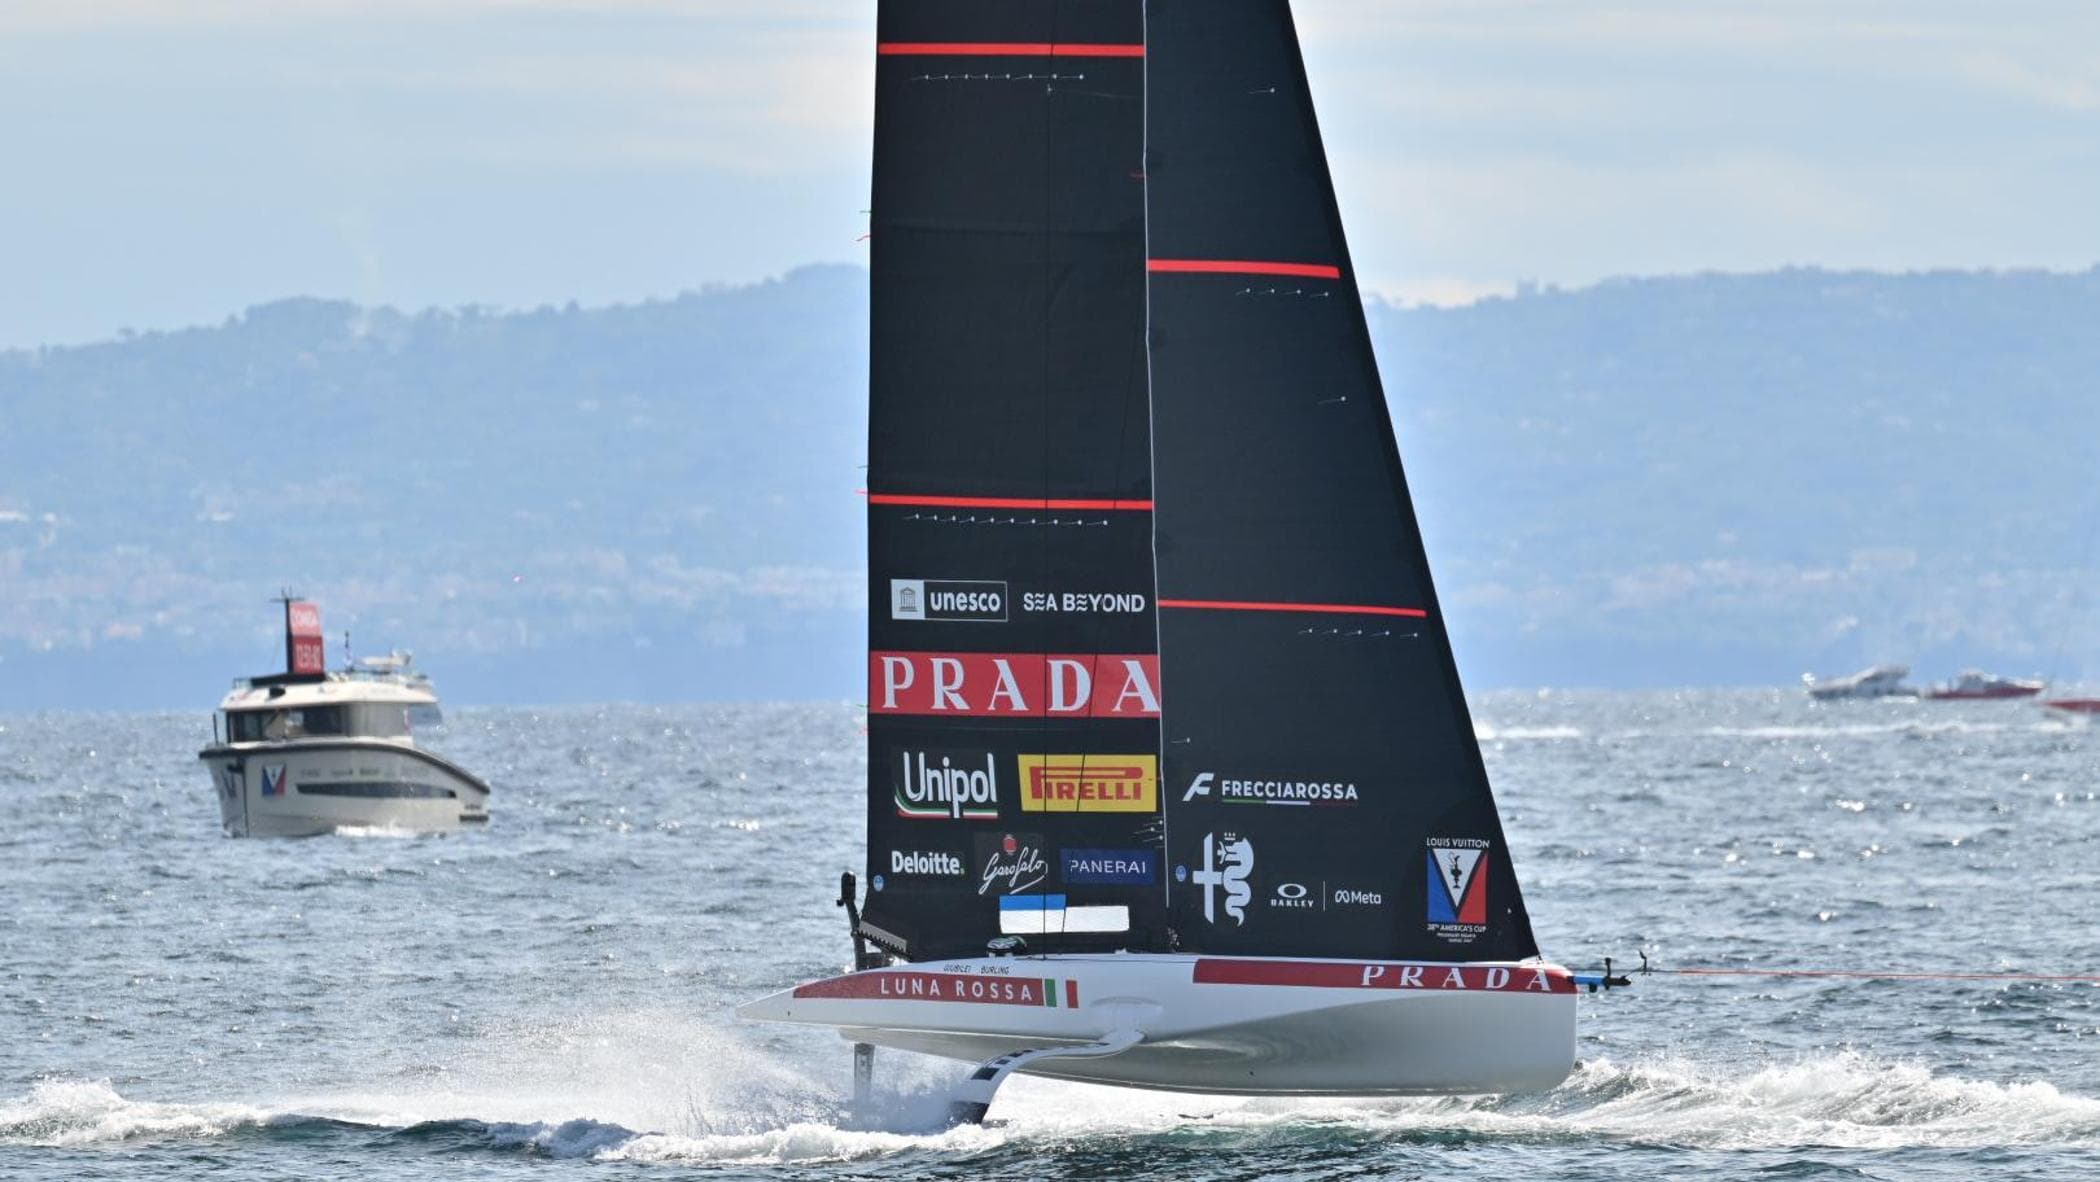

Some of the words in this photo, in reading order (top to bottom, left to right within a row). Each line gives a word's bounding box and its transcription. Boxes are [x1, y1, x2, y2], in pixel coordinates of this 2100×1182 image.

[930, 591, 1001, 612] unesco
[1023, 593, 1058, 612] SEA
[1063, 593, 1146, 613] BEYOND
[881, 656, 1160, 711] PRADA
[903, 751, 999, 819] Unipol
[1029, 766, 1144, 800] PIRELLI
[1221, 780, 1359, 800] FRECCIAROSSA
[1426, 837, 1450, 847] LOUIS
[1453, 838, 1490, 849] VUITTON
[978, 846, 1048, 895] Garofalo
[1070, 859, 1146, 875] PANERAI
[1271, 899, 1314, 908] OAKLEY
[1351, 891, 1382, 905] Meta
[1361, 965, 1551, 992] PRADA
[880, 978, 940, 996] LUNA
[956, 981, 1033, 1001] ROSSA
